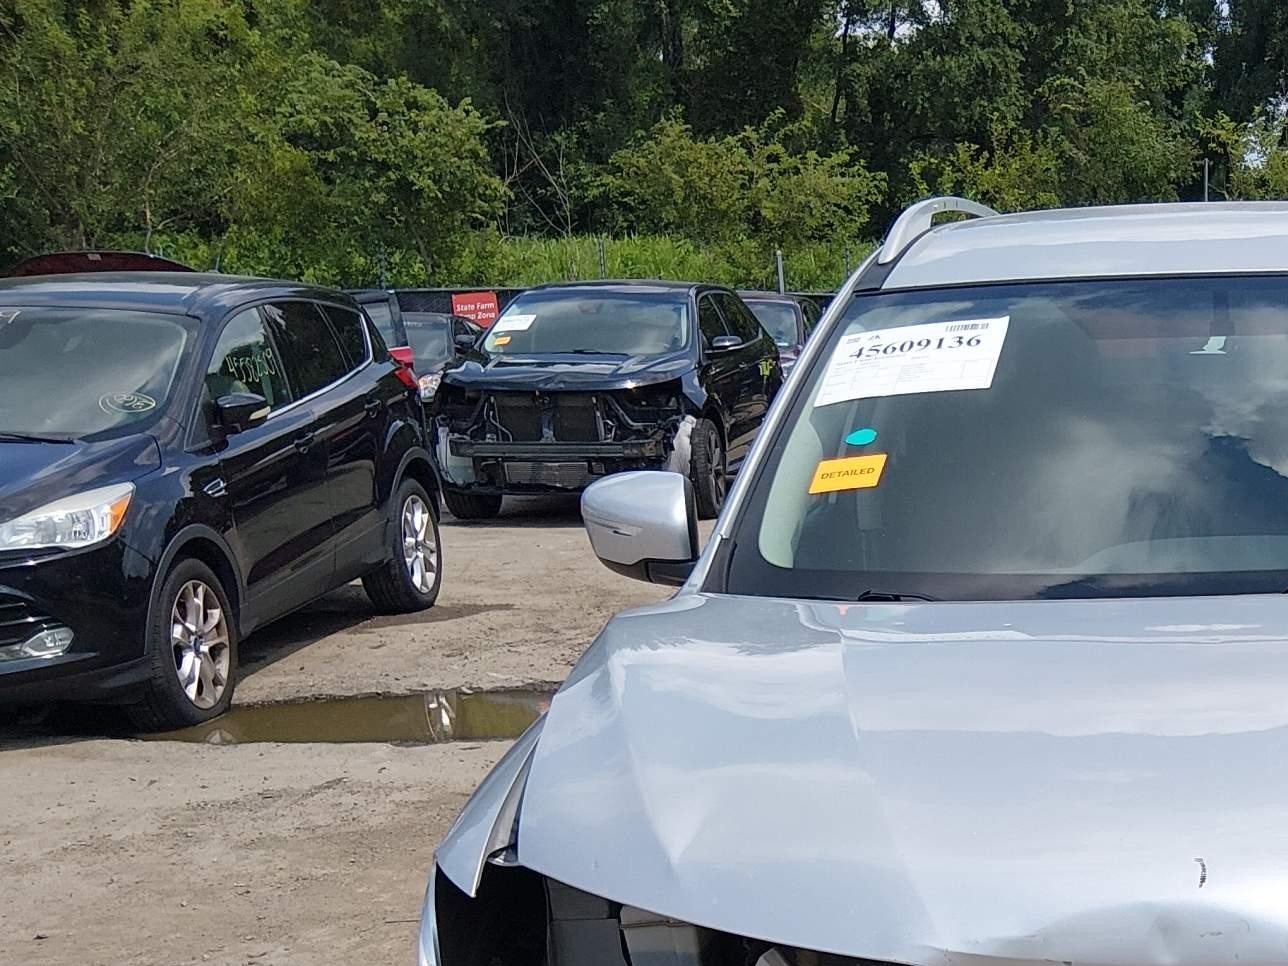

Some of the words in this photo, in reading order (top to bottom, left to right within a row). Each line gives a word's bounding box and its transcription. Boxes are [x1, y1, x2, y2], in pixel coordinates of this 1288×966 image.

[476, 302, 494, 310] Farm
[849, 334, 982, 359] 45609136
[820, 467, 875, 480] DETAILED
